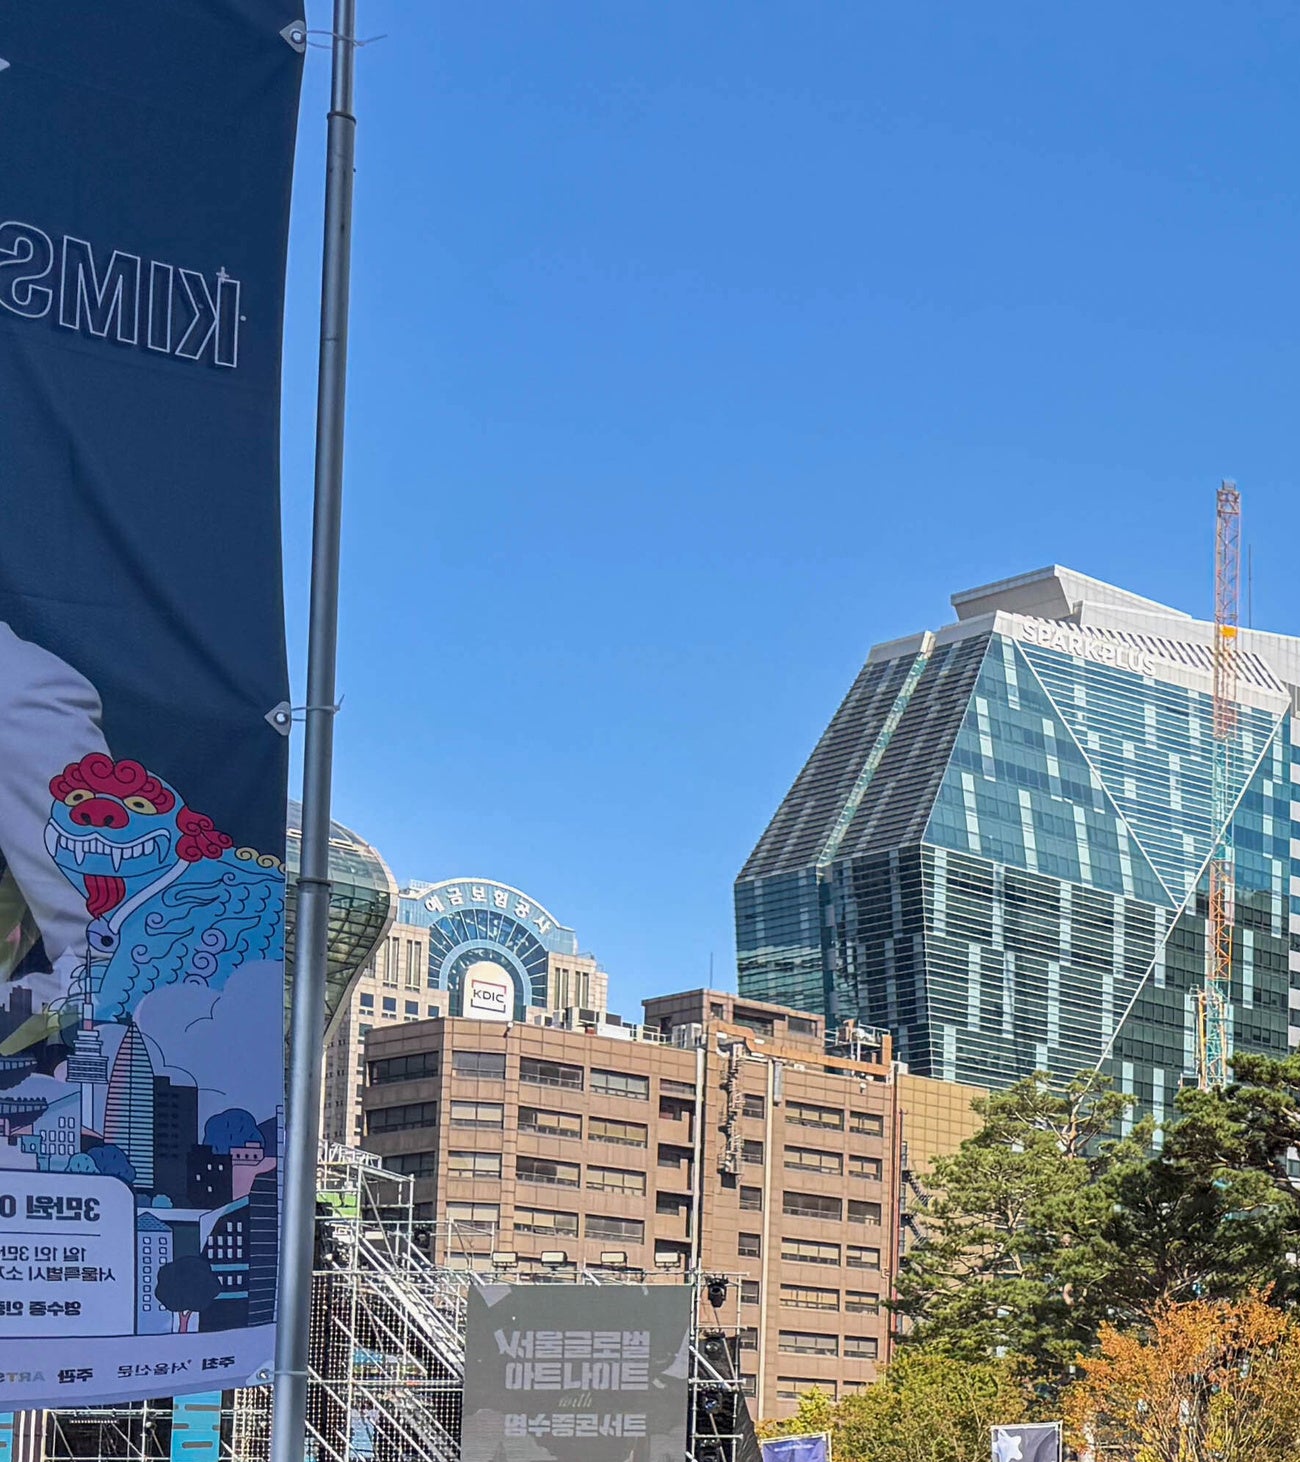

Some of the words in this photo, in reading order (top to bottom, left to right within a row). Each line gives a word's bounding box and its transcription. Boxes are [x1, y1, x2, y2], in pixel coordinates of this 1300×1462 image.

[424, 885, 553, 936] 예금보험공사
[472, 988, 506, 1005] KDIC
[494, 1328, 650, 1359] 서울글로벌
[505, 1362, 649, 1391] 아트나이트
